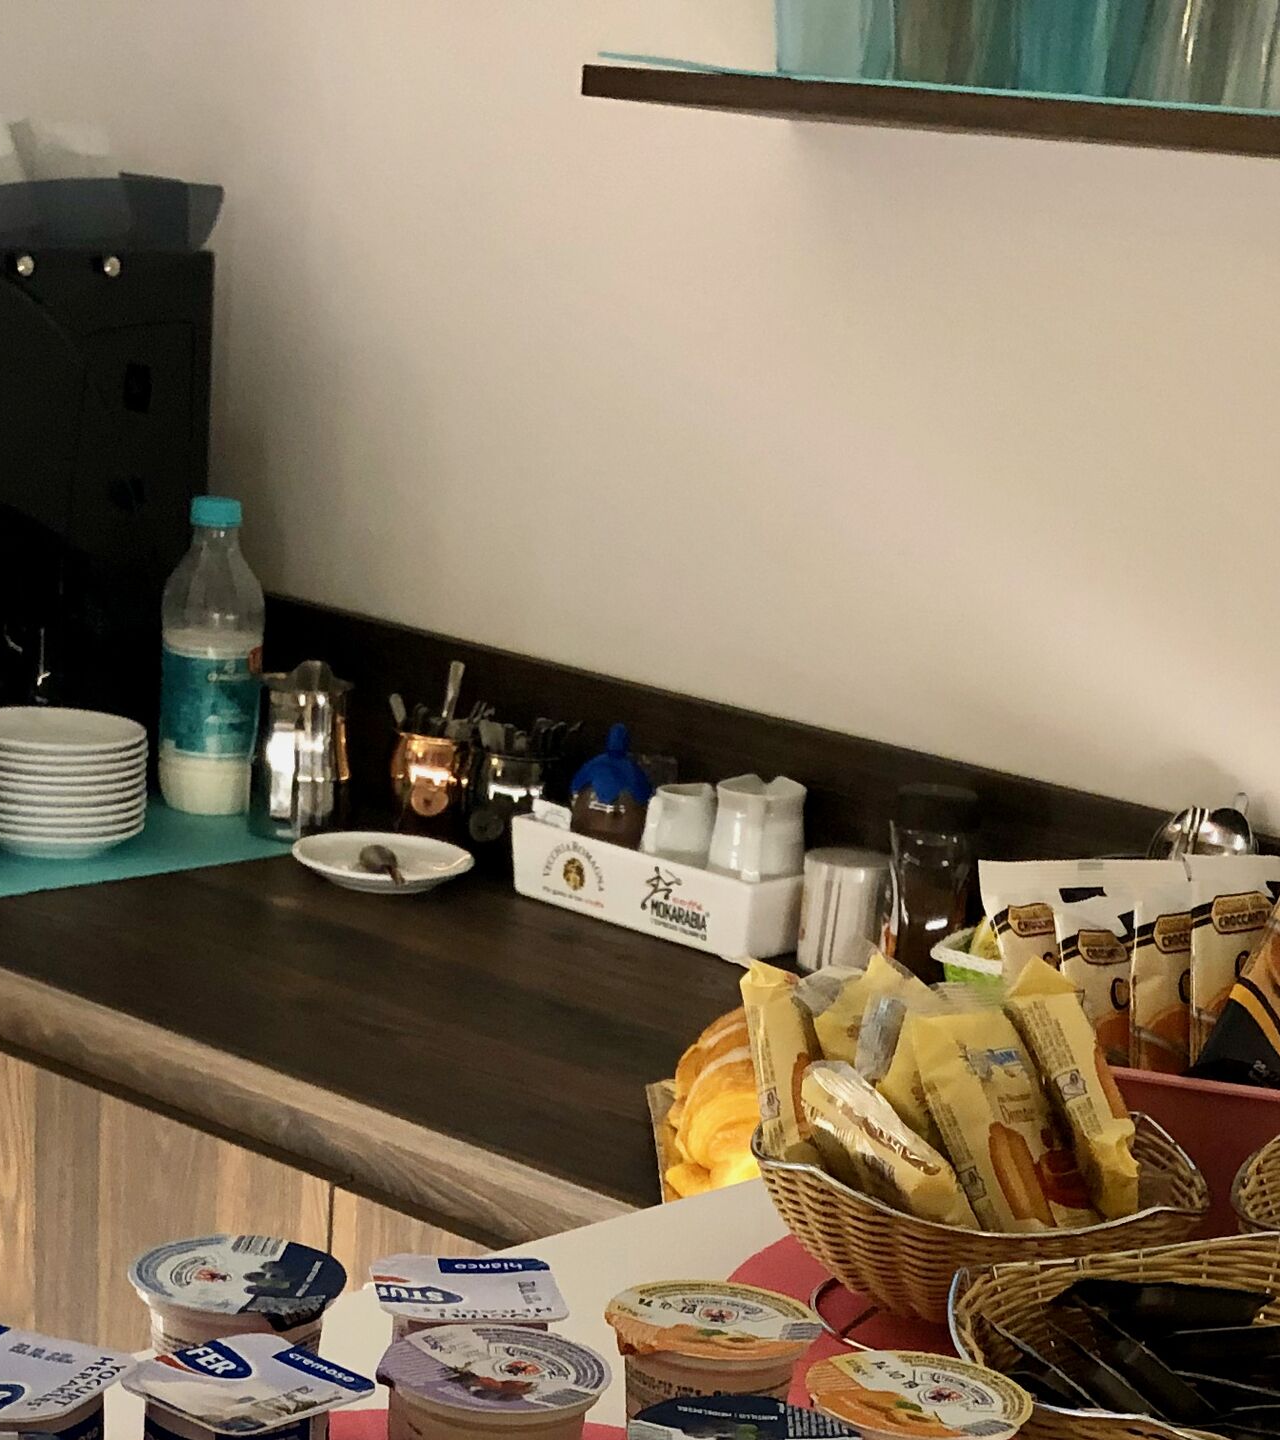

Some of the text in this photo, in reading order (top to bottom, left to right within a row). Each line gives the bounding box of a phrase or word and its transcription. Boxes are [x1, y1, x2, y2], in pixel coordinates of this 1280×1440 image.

[650, 899, 708, 933] MOKARABIA
[54, 1363, 127, 1407] YOGURT
[287, 1352, 356, 1385] cremoso
